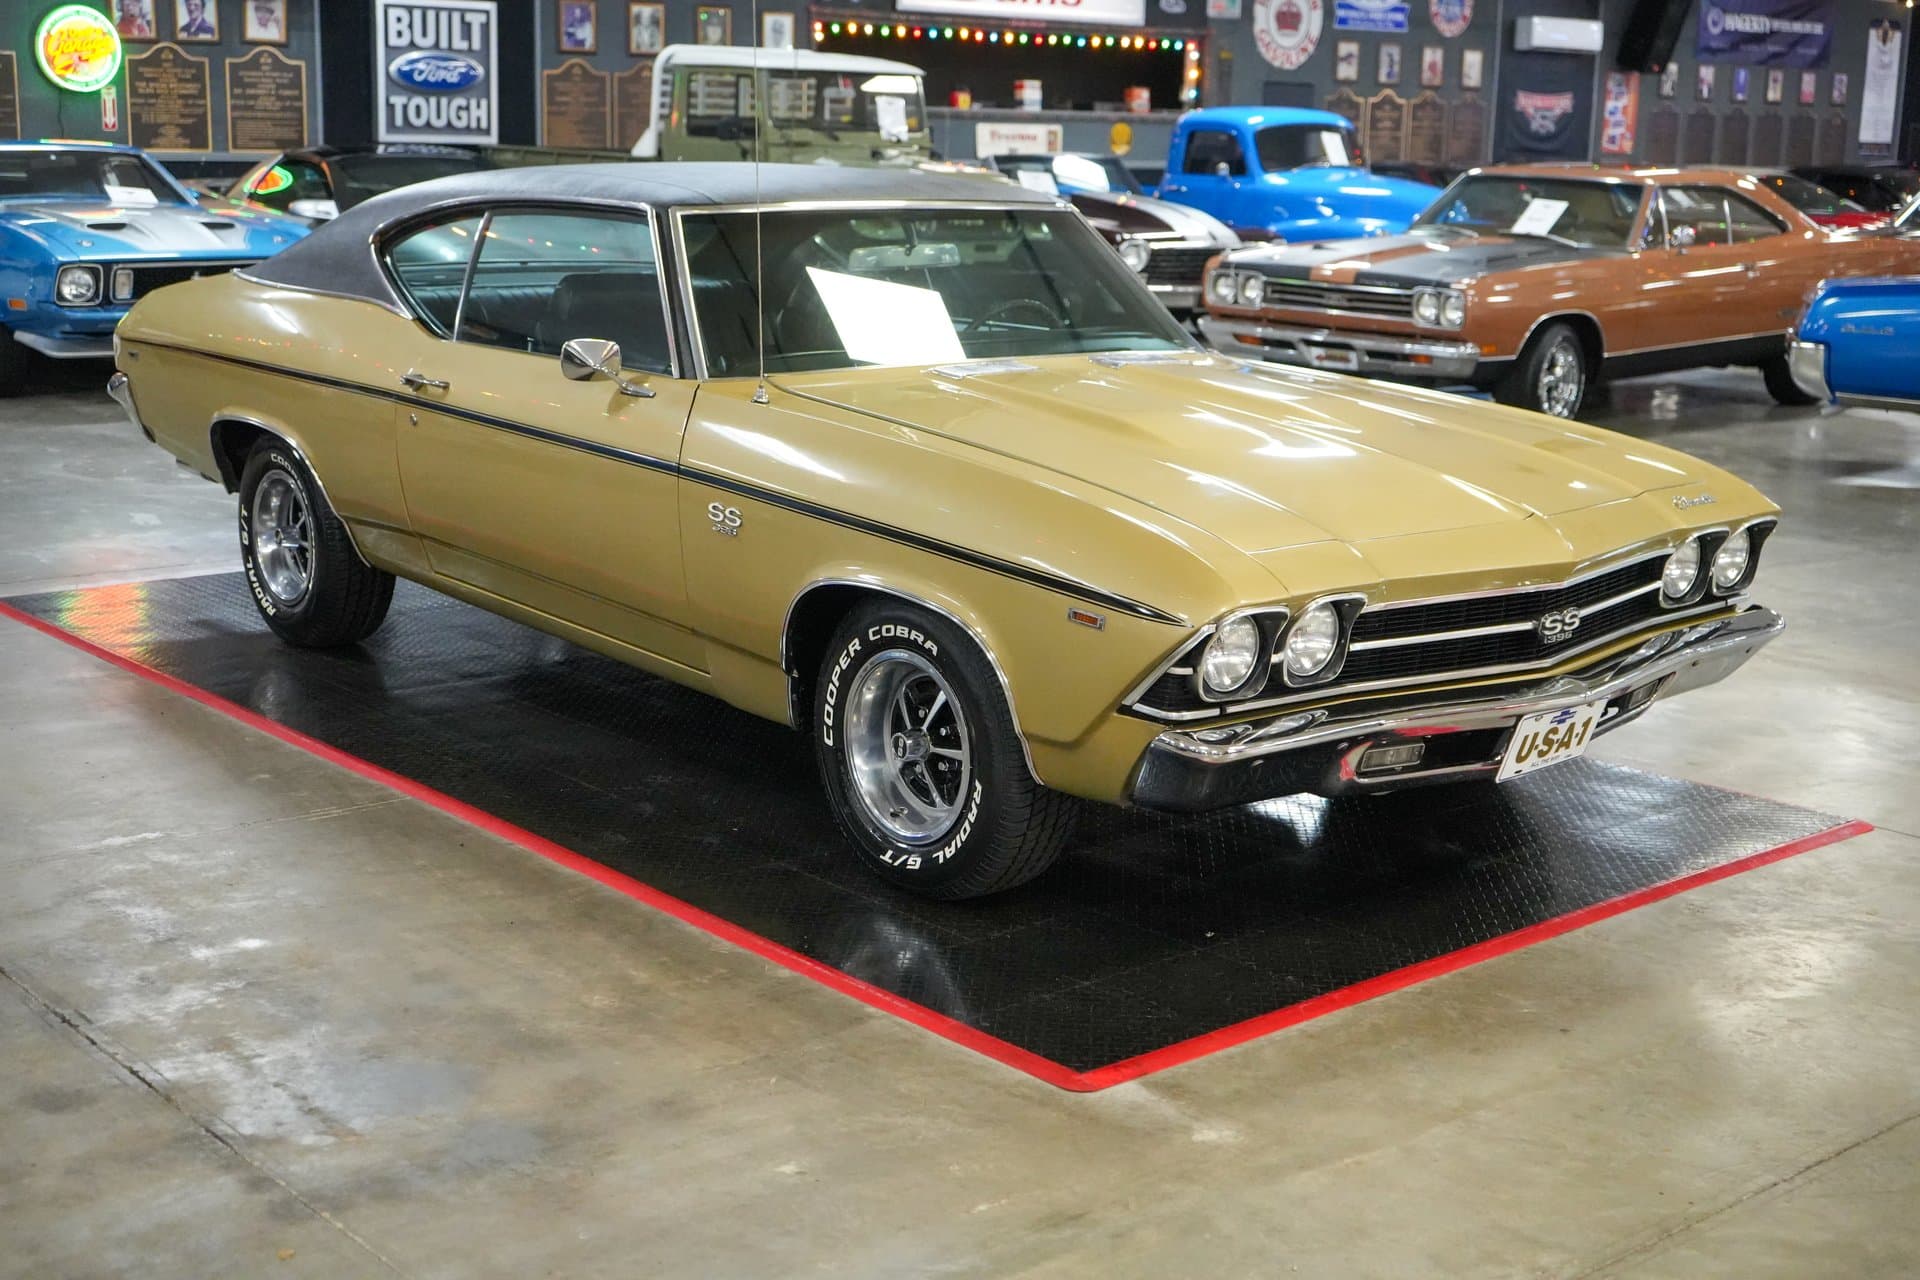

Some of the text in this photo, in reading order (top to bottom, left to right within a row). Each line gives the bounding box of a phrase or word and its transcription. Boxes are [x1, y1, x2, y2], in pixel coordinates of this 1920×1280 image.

[386, 6, 488, 51] BUILT
[399, 59, 470, 83] Ford
[388, 95, 489, 129] TOUGH
[708, 502, 742, 526] SS
[246, 555, 277, 617] RADIAL
[1543, 608, 1580, 635] SS
[823, 624, 939, 747] COOPER COBRA
[879, 778, 983, 870] RADIAL G/T
